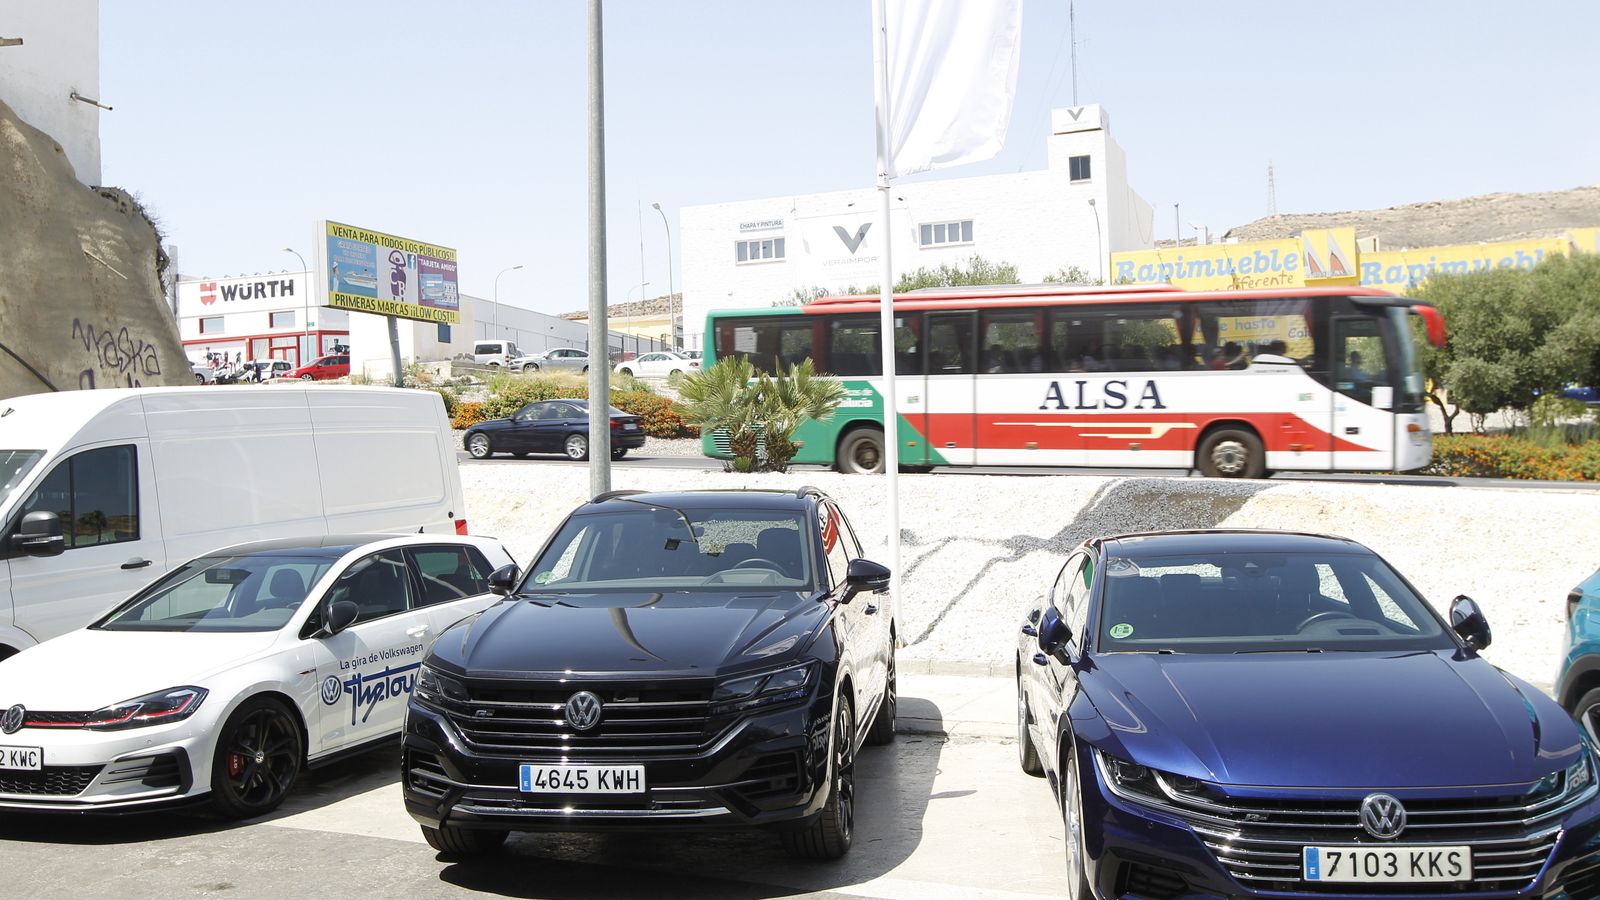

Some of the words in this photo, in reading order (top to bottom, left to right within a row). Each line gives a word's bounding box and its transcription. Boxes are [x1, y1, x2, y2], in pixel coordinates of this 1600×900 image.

[740, 222, 757, 230] CHAPA
[760, 220, 782, 228] PINTURA
[333, 225, 358, 240] VENTA
[359, 232, 379, 245] PARA
[381, 236, 403, 250] TODOS
[405, 242, 417, 254] LOS
[822, 256, 880, 267] VERAIMPOR
[1115, 249, 1299, 284] Rapimueble
[1360, 249, 1545, 289] Rapimuebl
[220, 279, 294, 302] WÜRTH
[335, 293, 376, 310] PRIMERAS
[377, 301, 409, 316] MARCAS
[1235, 319, 1275, 330] hasta
[1039, 380, 1167, 410] ALSA
[340, 660, 350, 670] La
[351, 656, 367, 669] gira
[368, 653, 379, 663] de
[379, 643, 424, 660] Volkswagen
[10, 750, 37, 767] KWC
[535, 769, 588, 789] 4645
[598, 769, 640, 790] KWH
[1326, 852, 1398, 877] 7103
[1410, 851, 1462, 877] KKS
